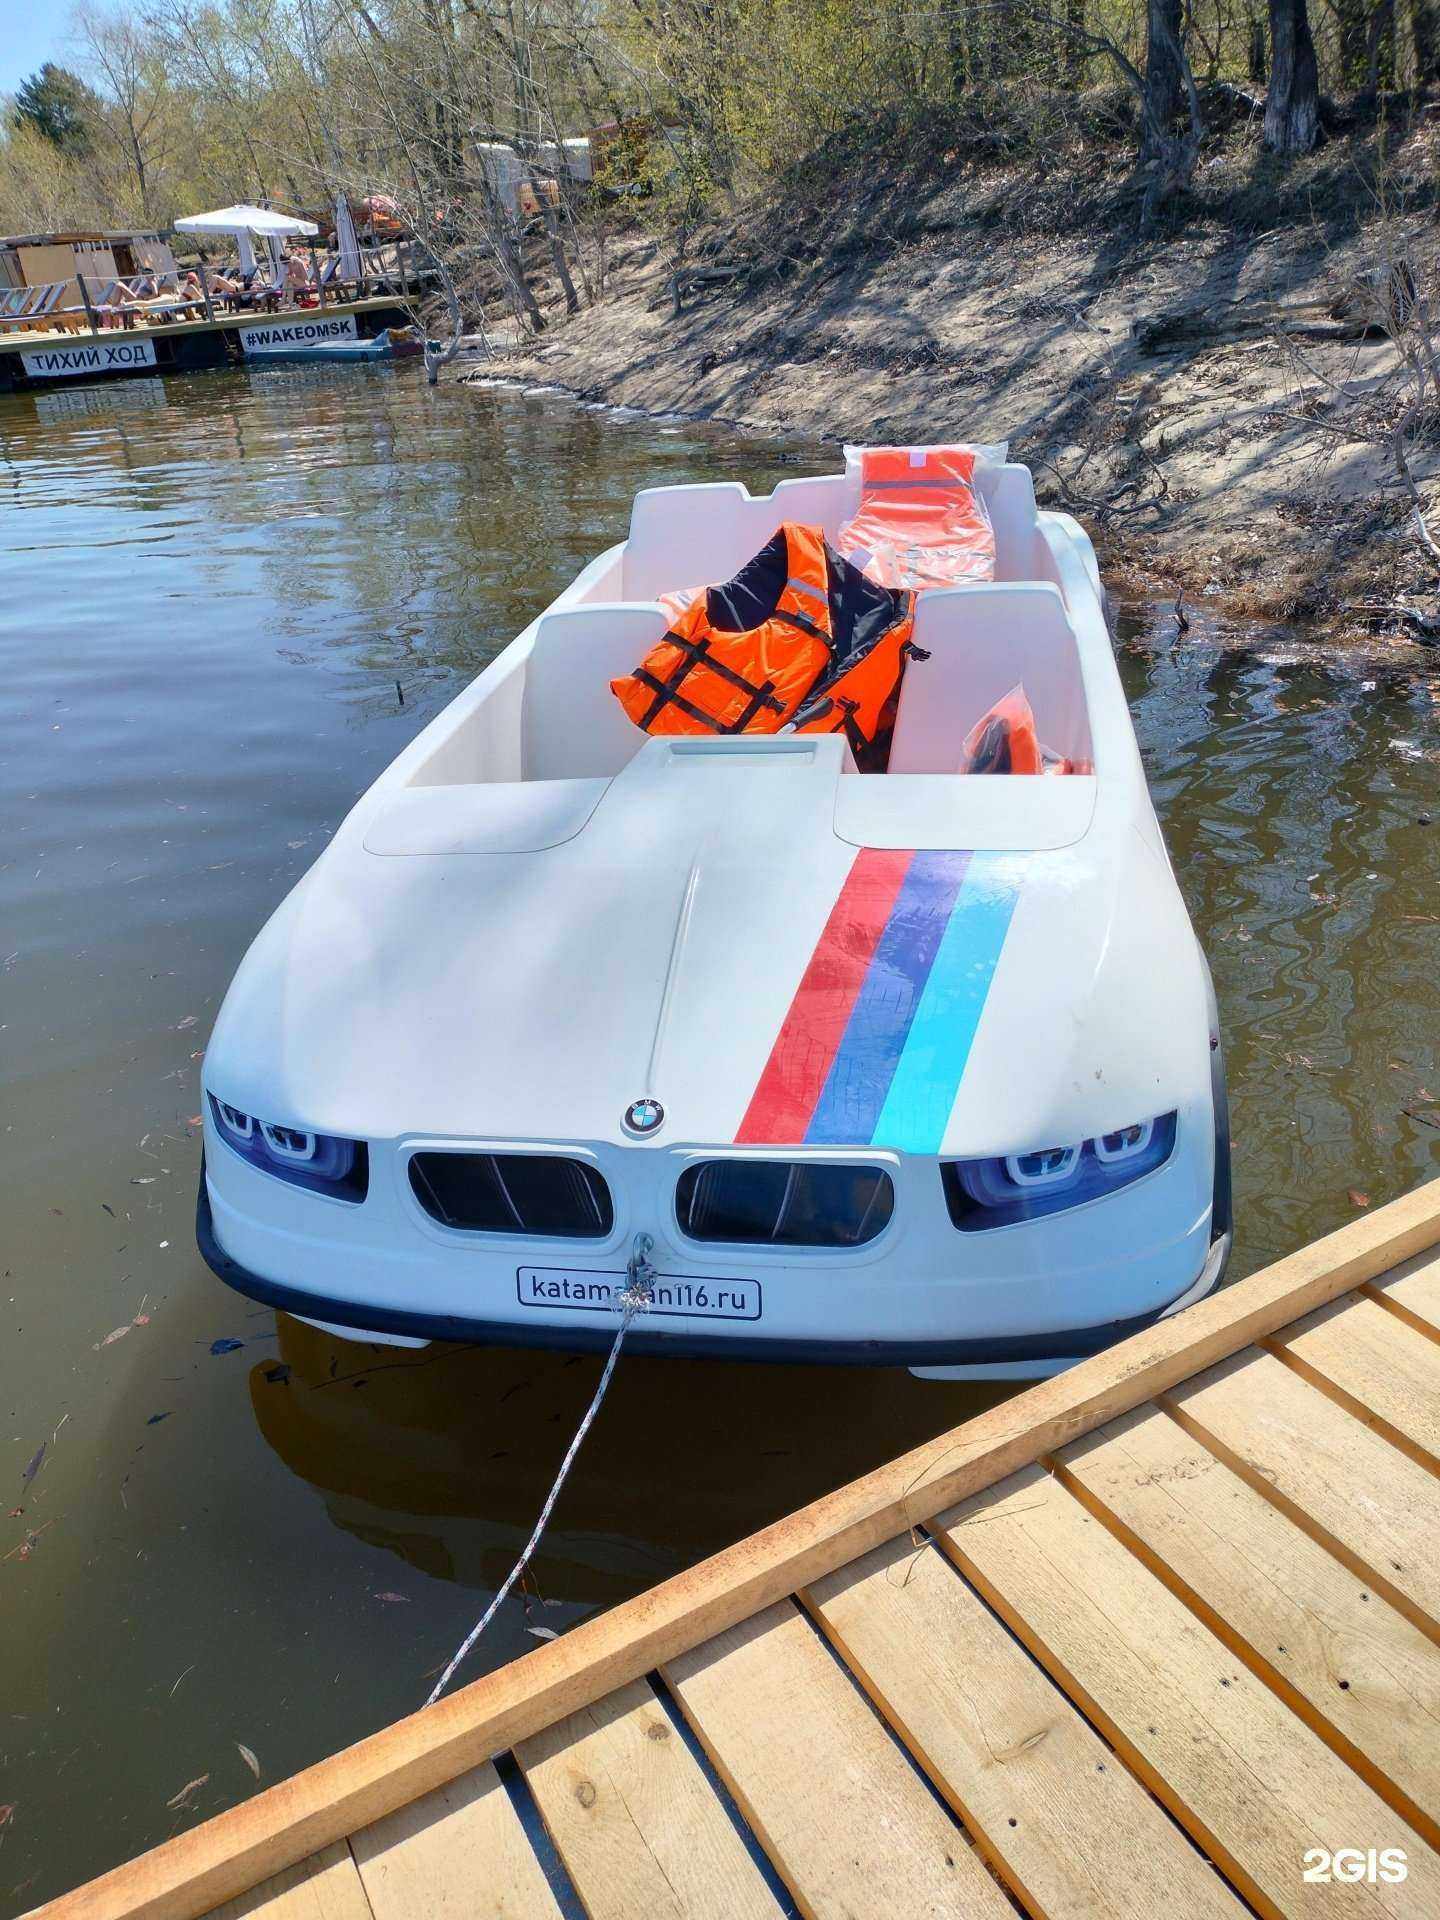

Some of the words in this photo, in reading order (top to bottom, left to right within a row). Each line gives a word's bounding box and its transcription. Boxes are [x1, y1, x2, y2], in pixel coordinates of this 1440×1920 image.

[245, 319, 352, 347] #WAKEOMSK
[31, 345, 101, 371] ТИХИЙ
[104, 345, 148, 364] ХОД
